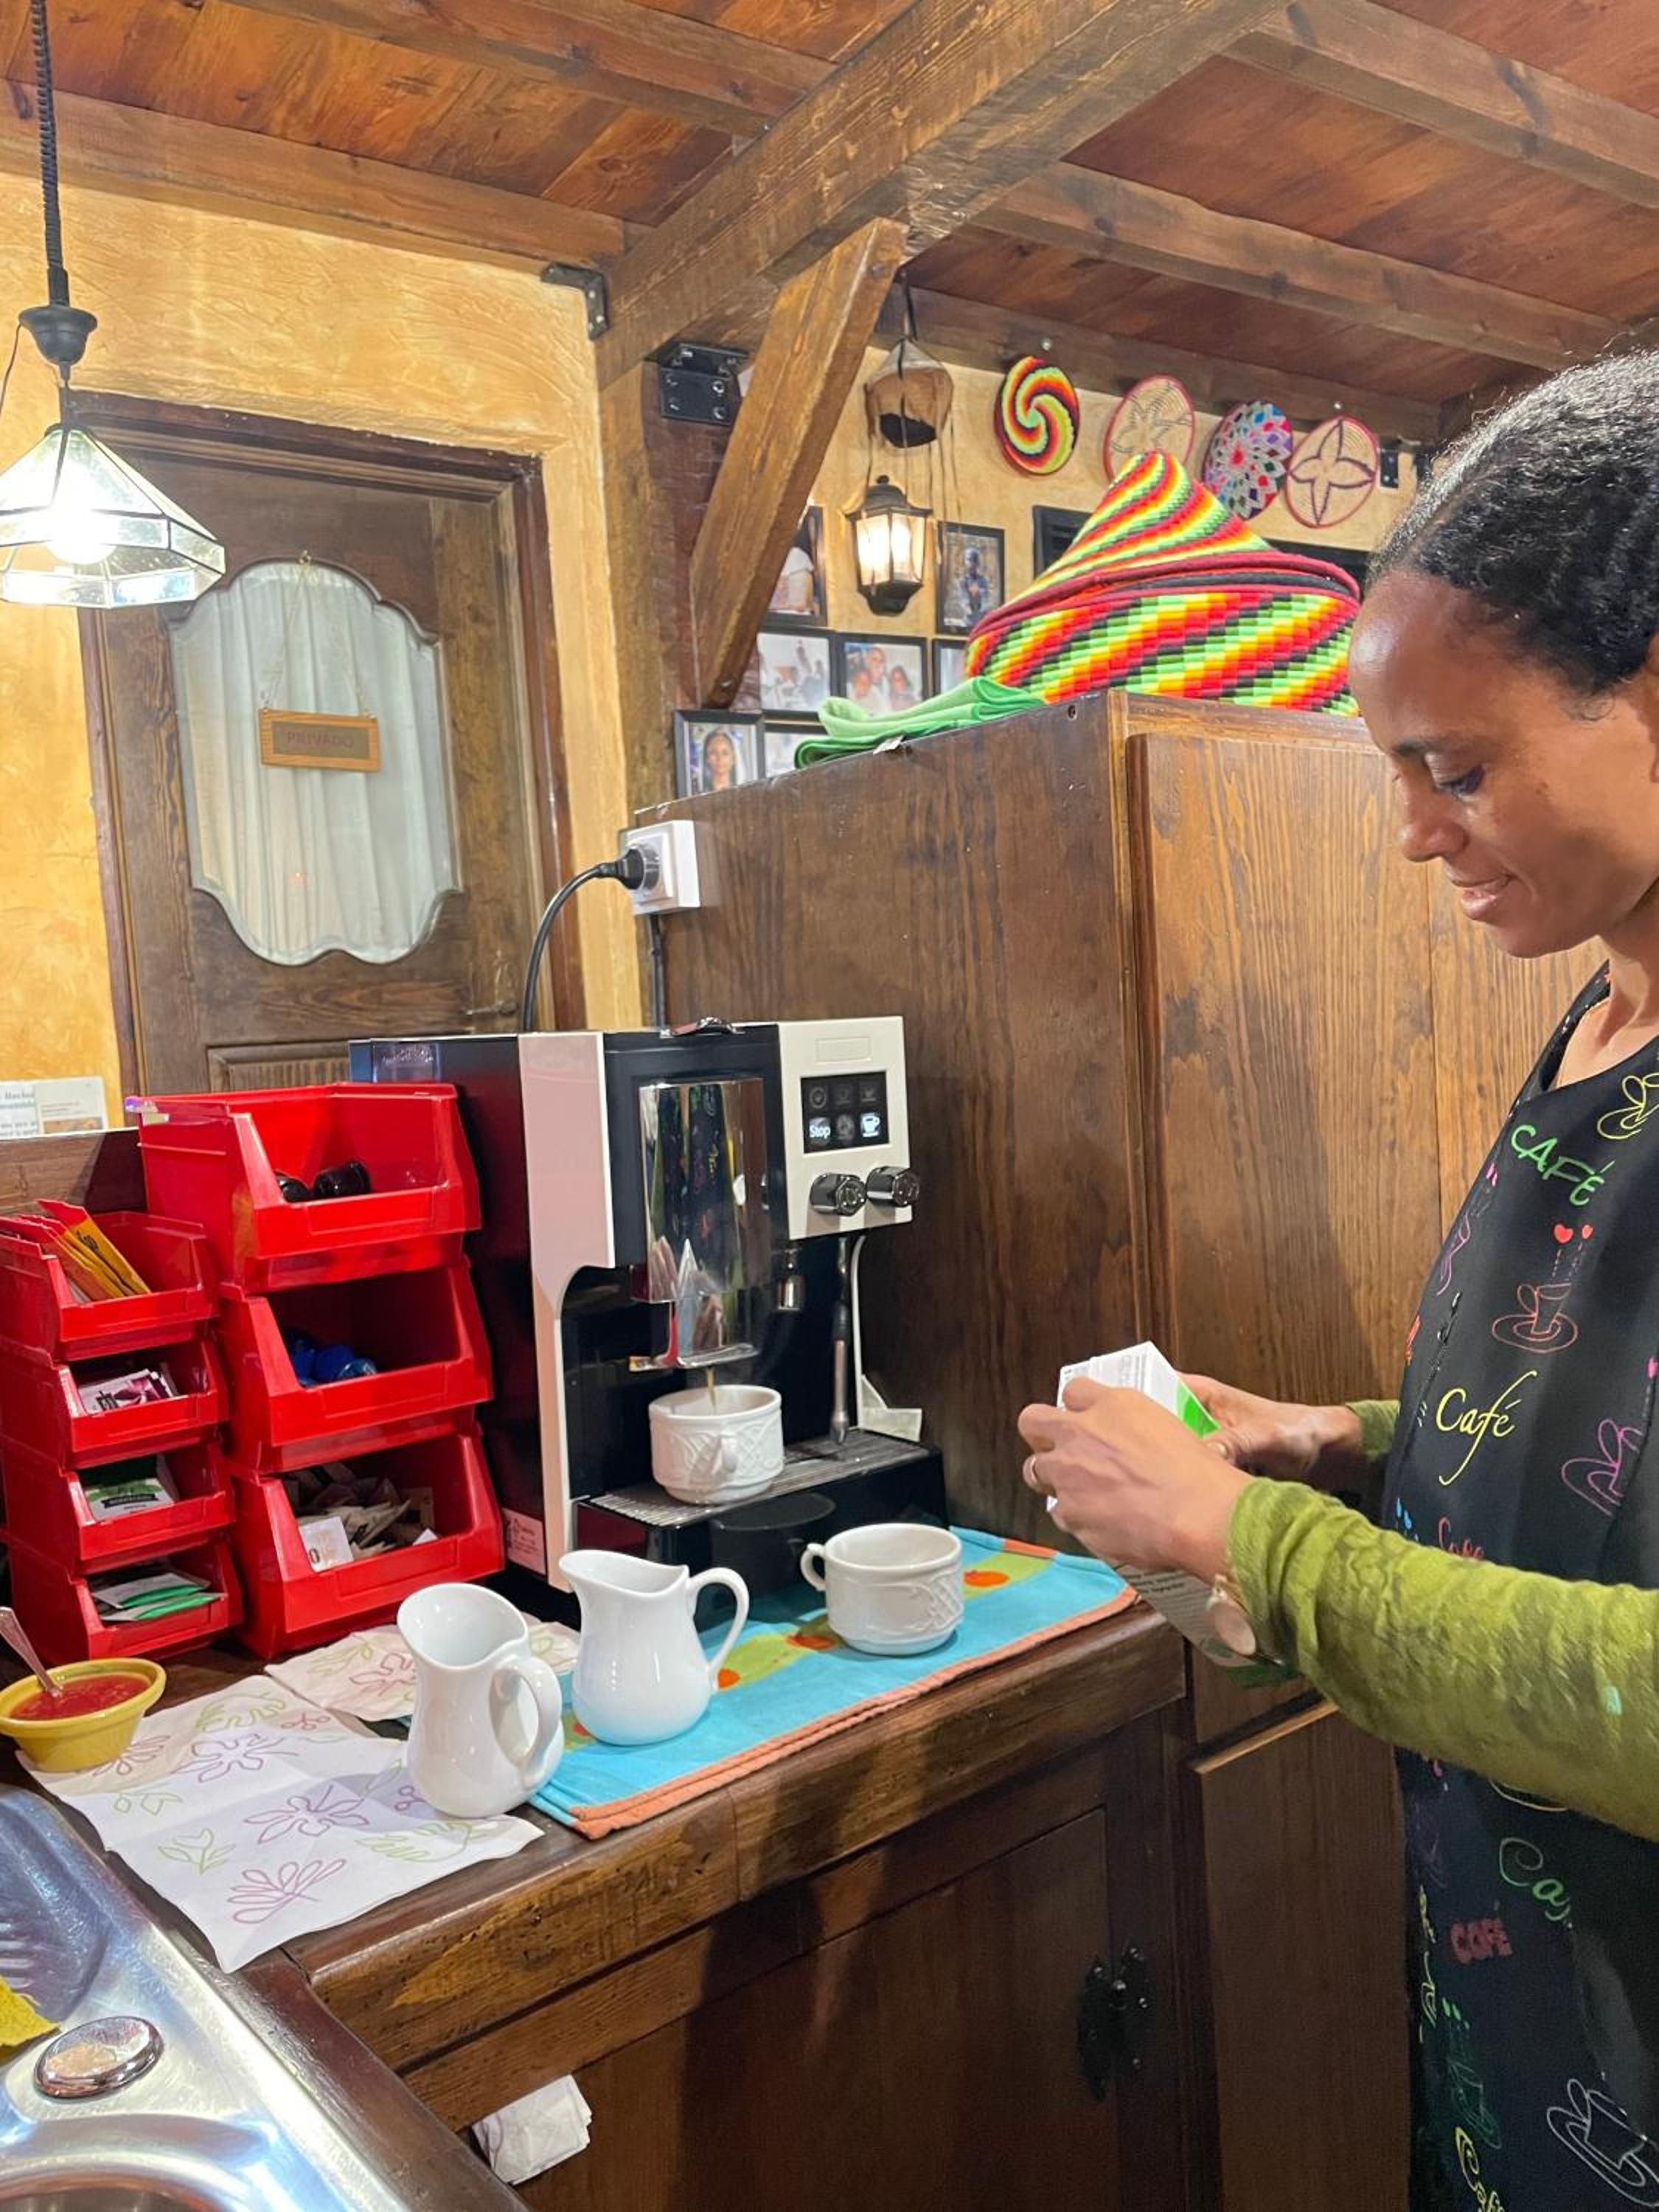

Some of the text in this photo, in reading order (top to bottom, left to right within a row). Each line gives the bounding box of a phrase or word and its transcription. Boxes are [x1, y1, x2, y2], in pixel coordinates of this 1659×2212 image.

[287, 731, 354, 748] PRIVADO
[809, 1124, 831, 1139] Stop
[1510, 1124, 1615, 1206] CAFÉ
[1436, 1370, 1537, 1485] Café
